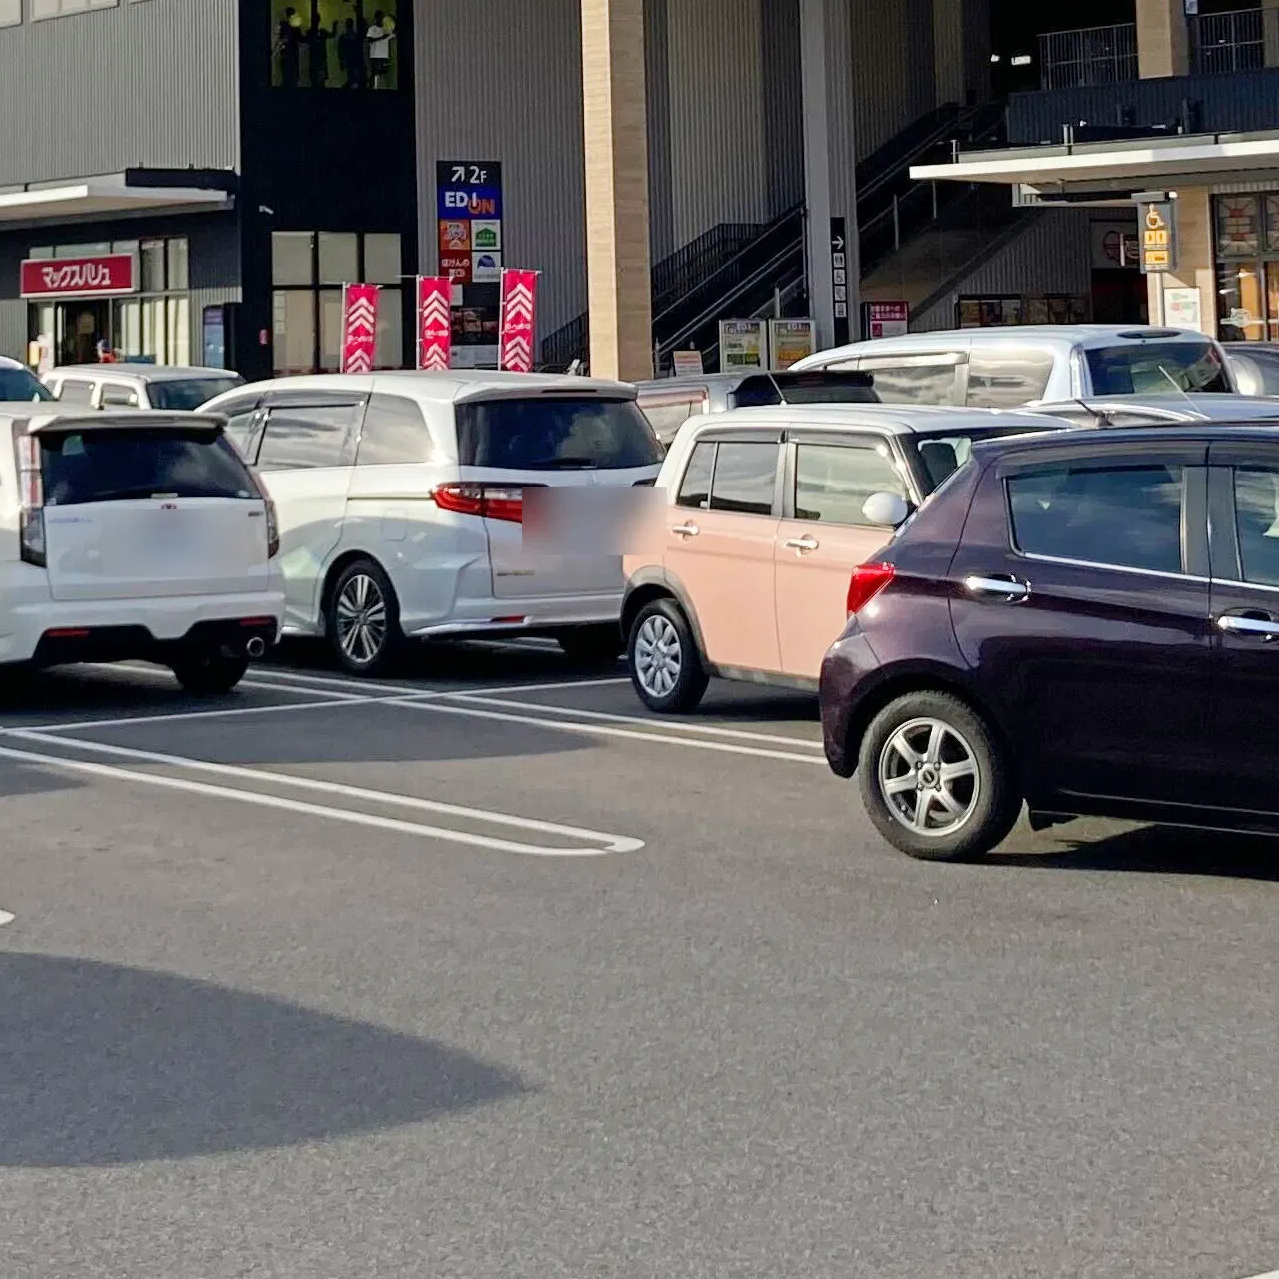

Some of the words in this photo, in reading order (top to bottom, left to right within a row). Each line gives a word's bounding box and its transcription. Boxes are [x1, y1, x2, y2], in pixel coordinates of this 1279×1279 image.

[469, 165, 488, 184] 2F
[444, 191, 496, 215] EDION
[41, 262, 112, 290] マックスバリュ
